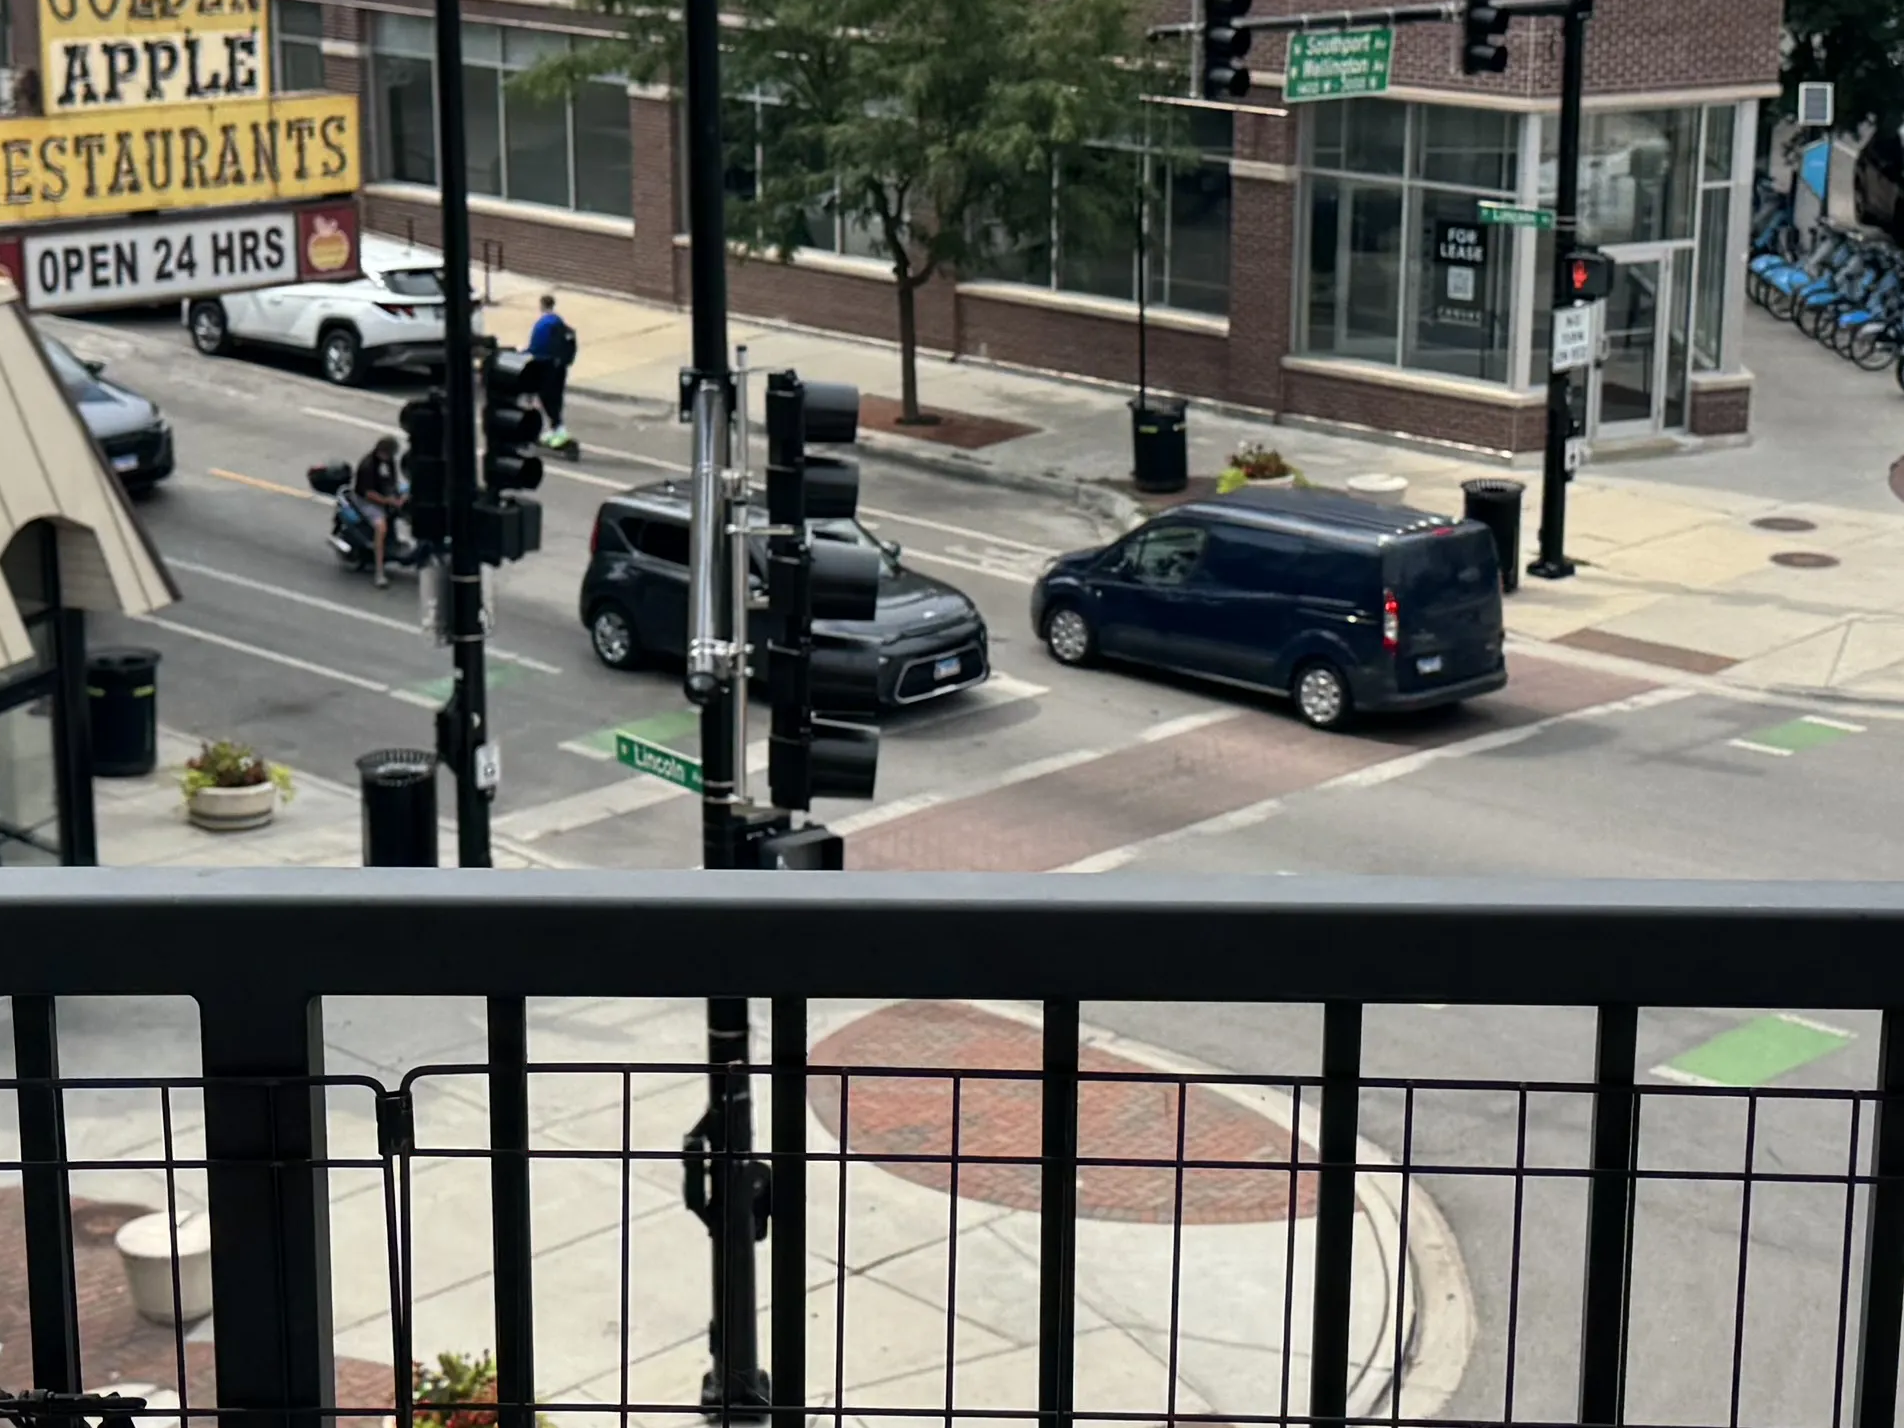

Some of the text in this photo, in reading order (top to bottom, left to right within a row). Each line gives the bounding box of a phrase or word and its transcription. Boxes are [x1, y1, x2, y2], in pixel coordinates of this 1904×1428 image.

[1305, 33, 1371, 57] Southport
[56, 30, 259, 110] APPLE
[1439, 242, 1484, 262] LEASE
[1447, 227, 1478, 245] FOR
[38, 225, 287, 294] OPEN 24 HRS
[634, 743, 687, 783] Lincoln
